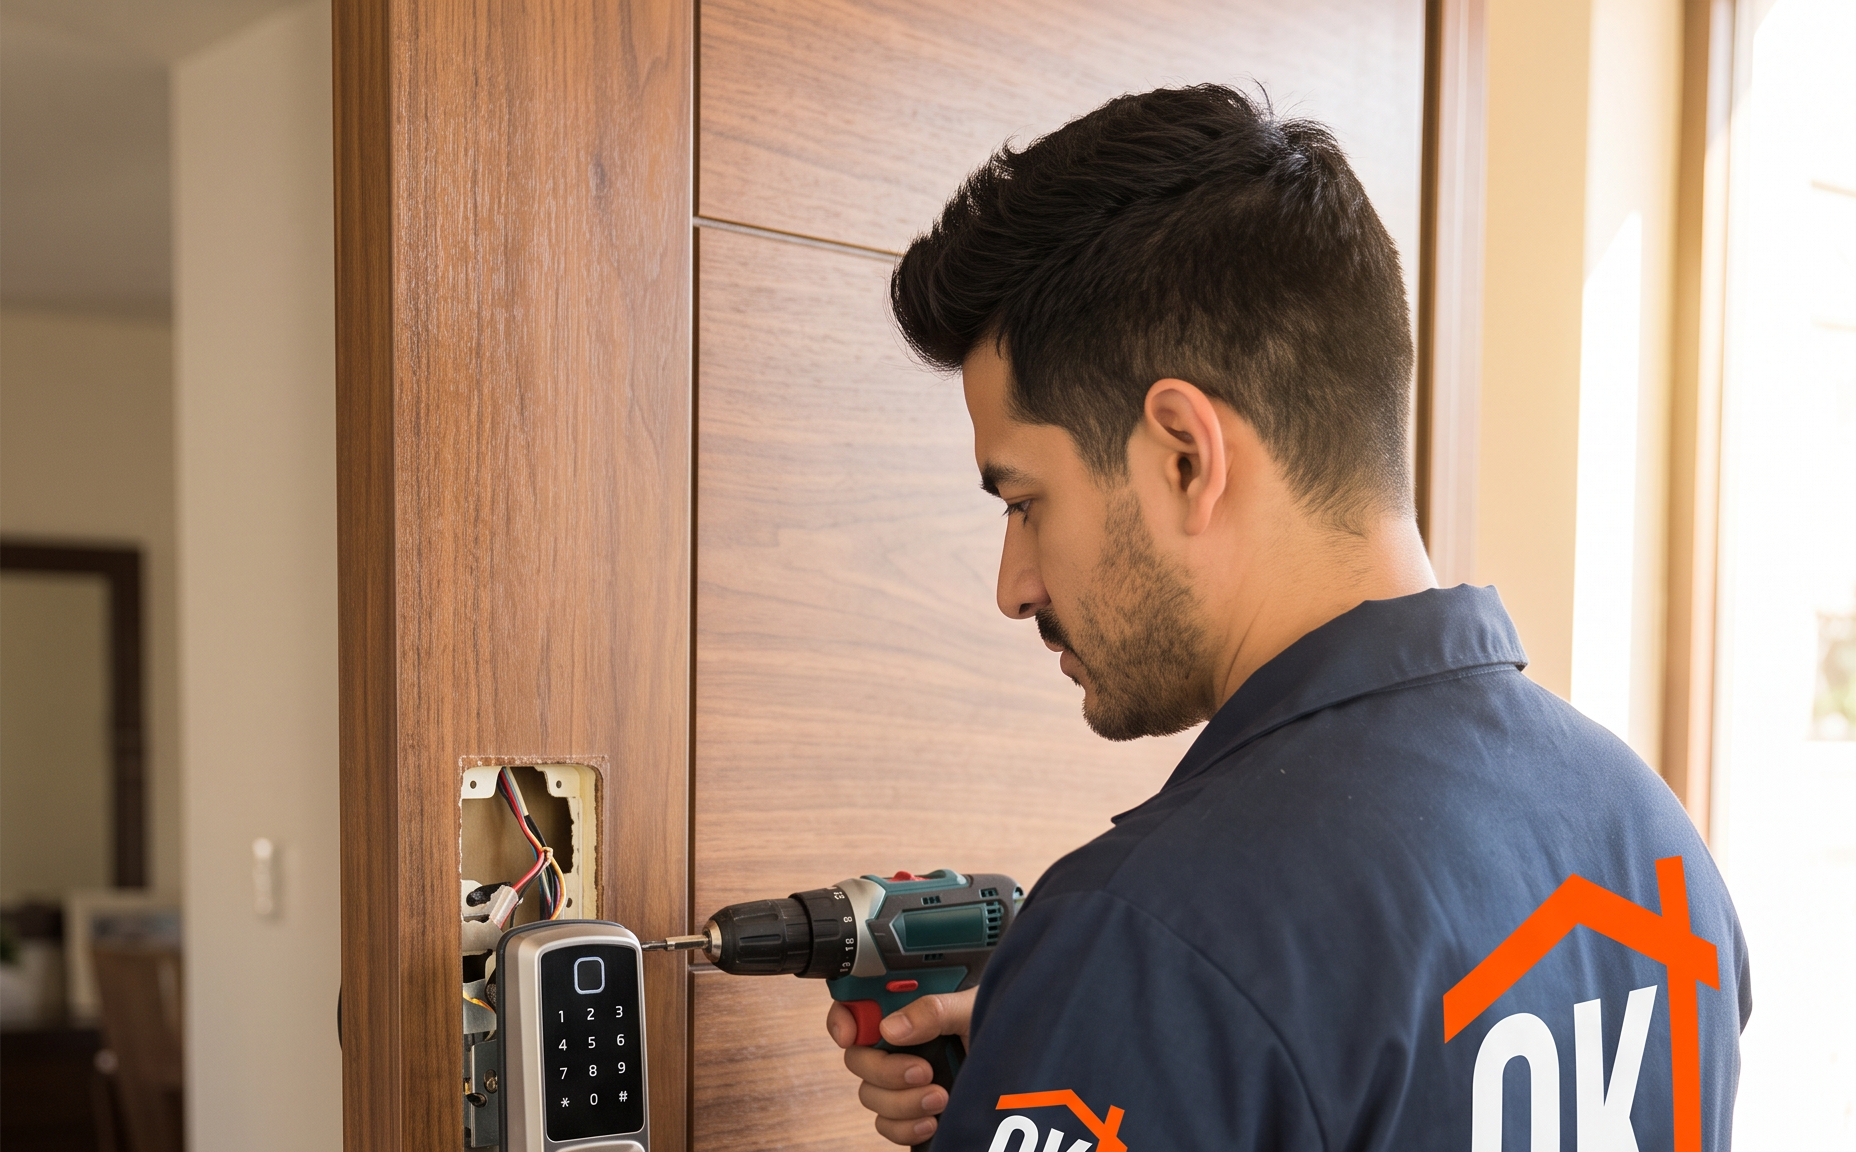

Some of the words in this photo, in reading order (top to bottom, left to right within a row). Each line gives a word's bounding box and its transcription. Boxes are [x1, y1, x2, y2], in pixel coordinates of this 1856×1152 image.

[558, 1010, 564, 1023] 1
[586, 1008, 595, 1020] 2
[615, 1006, 623, 1018] 3
[558, 1039, 567, 1051] 4
[588, 1036, 596, 1048] 5
[616, 1034, 625, 1046] 6
[559, 1067, 568, 1079] 7
[589, 1064, 597, 1077] 8
[618, 1062, 626, 1073] 9
[590, 1093, 598, 1105] 0
